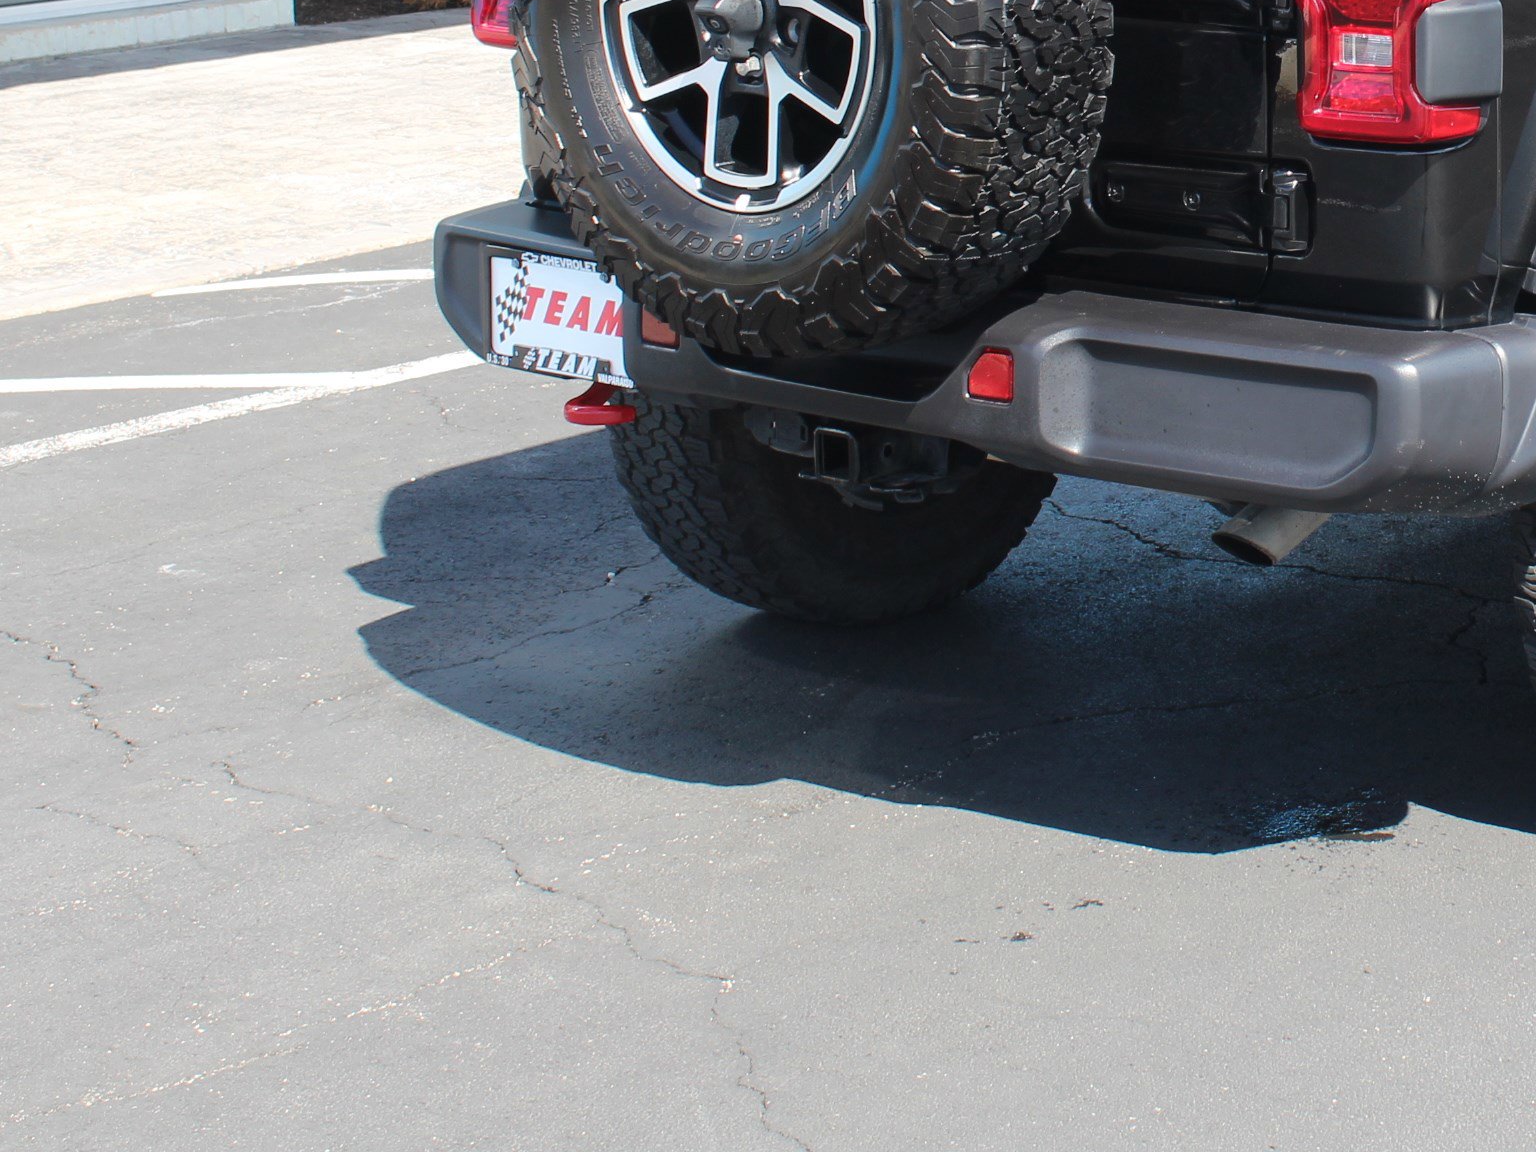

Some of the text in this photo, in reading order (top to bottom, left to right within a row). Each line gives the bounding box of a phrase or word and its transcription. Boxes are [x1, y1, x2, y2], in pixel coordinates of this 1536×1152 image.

[539, 254, 598, 272] CHEVROLET
[522, 286, 624, 338] TEAM
[536, 348, 598, 377] TEAM
